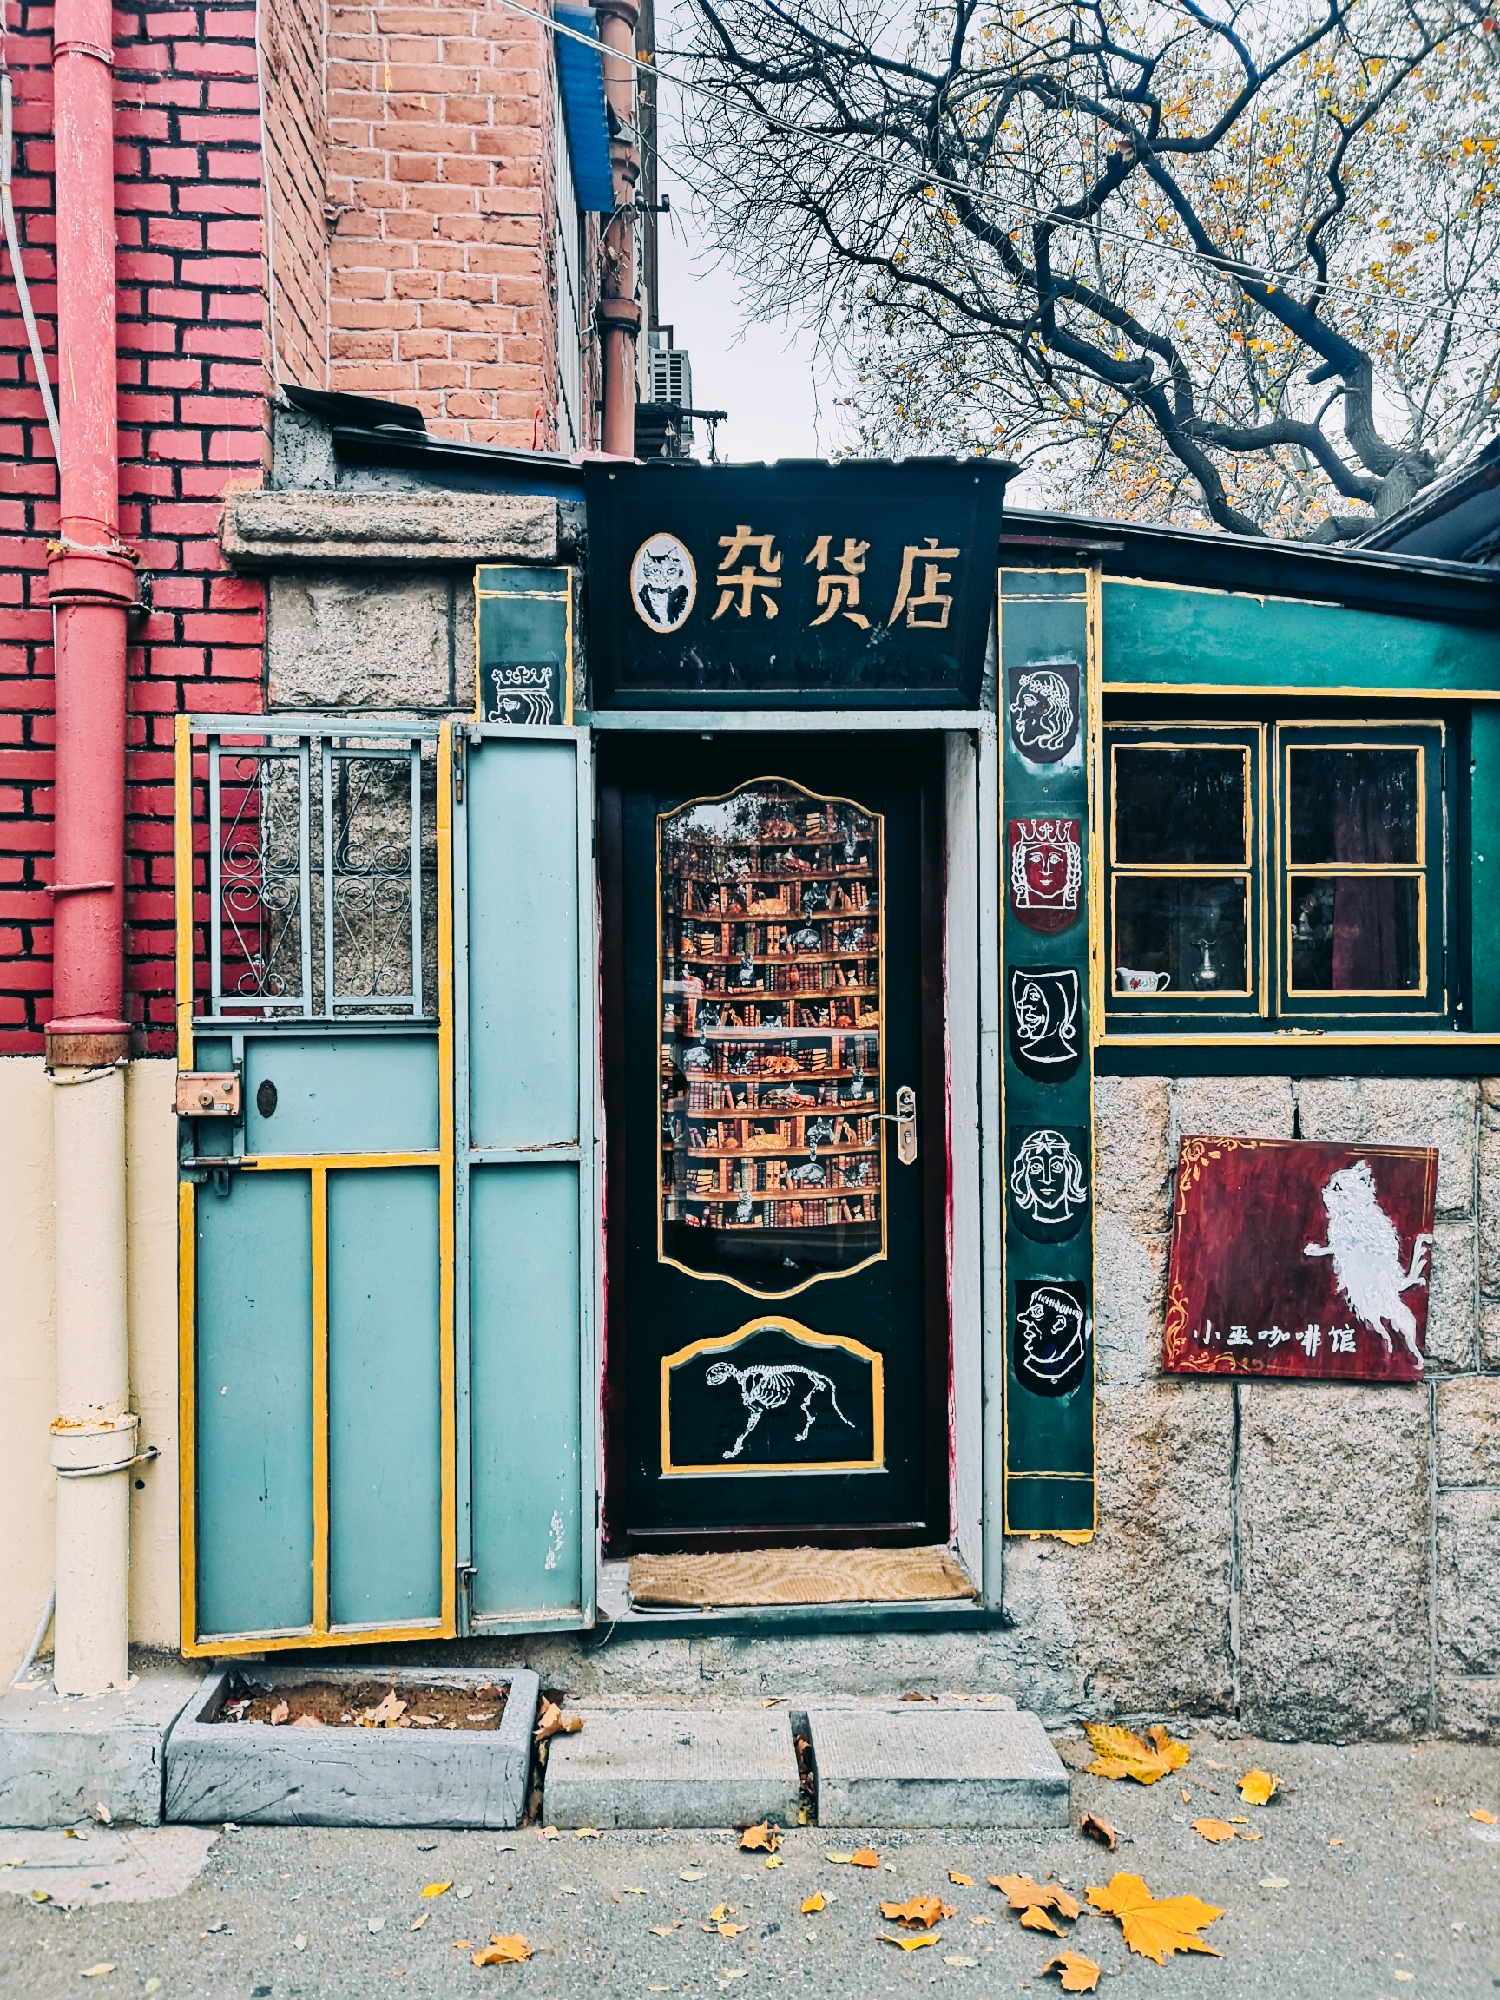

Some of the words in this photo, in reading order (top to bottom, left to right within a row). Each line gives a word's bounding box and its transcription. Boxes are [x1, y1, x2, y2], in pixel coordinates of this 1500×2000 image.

[711, 524, 960, 629] 杂货店
[1193, 1319, 1357, 1357] 小巫咖啡馆
